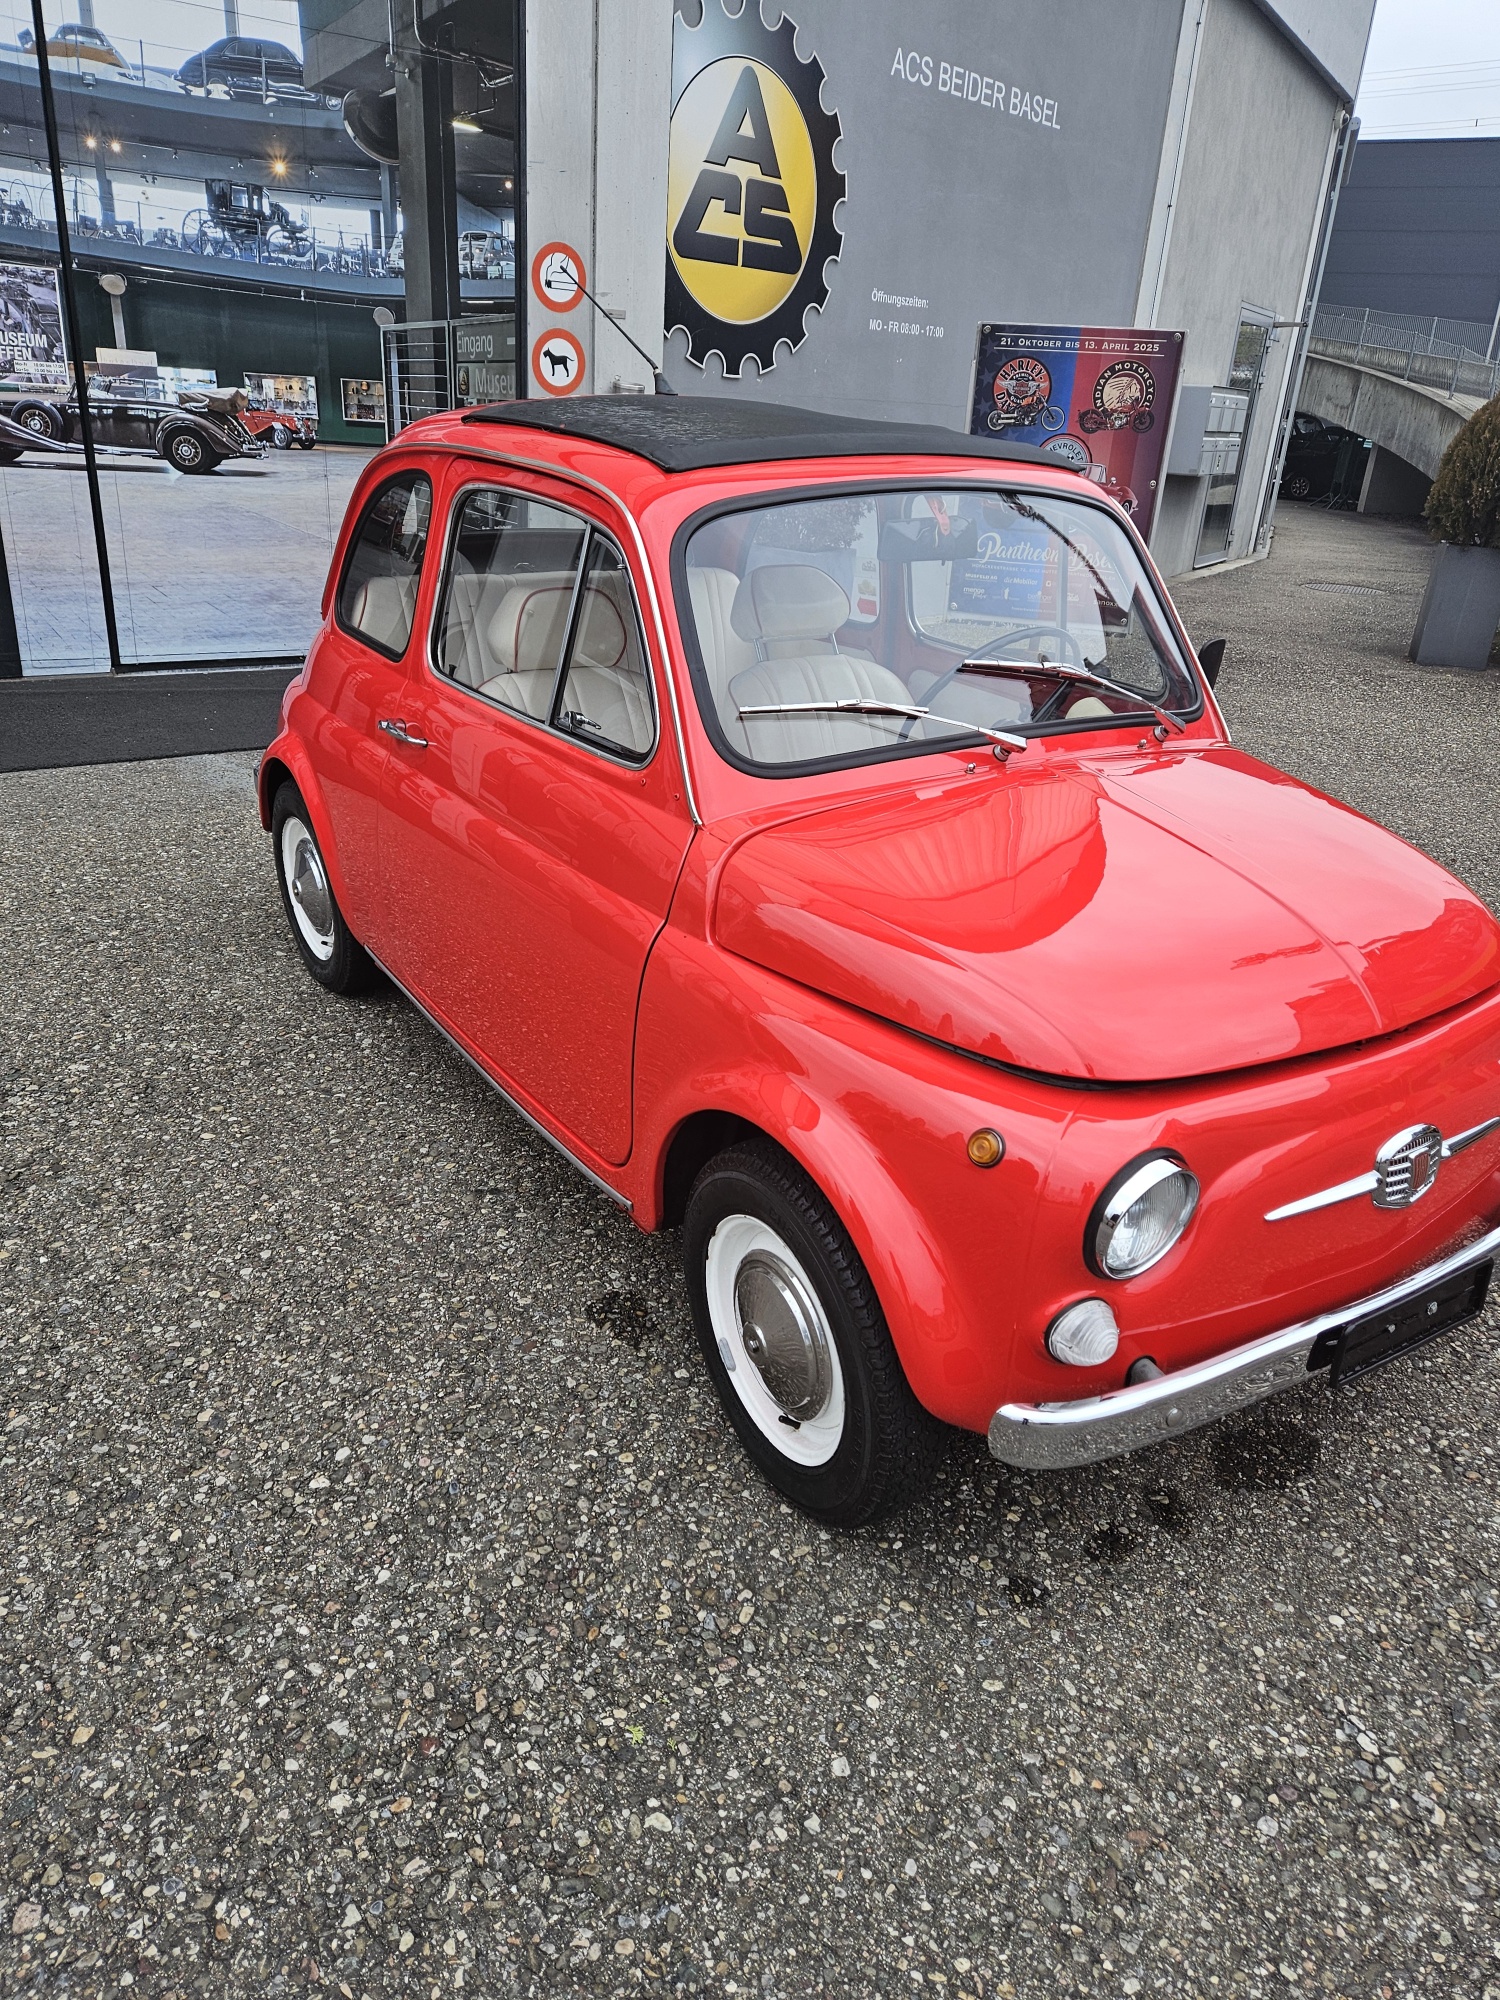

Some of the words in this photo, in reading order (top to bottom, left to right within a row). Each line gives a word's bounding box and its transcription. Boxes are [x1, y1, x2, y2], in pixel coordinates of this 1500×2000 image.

[890, 47, 933, 87] ACS
[938, 61, 1006, 111] BEIDER
[1009, 86, 1061, 130] BASEL
[871, 287, 929, 309] Öffnungszeiten:
[0, 331, 47, 348] USEUM
[869, 318, 883, 331] MO
[888, 320, 899, 333] FR
[900, 322, 920, 335] 08:00
[925, 325, 944, 338] 17:00
[0, 345, 32, 360] FFEN
[456, 330, 493, 359] Eingang
[1000, 337, 1015, 346] 21.
[1084, 341, 1098, 349] 13.
[1133, 343, 1160, 352] 2025
[475, 368, 515, 394] Museu
[1114, 362, 1155, 406] MOTORCYCL
[977, 532, 1059, 564] Pantheon
